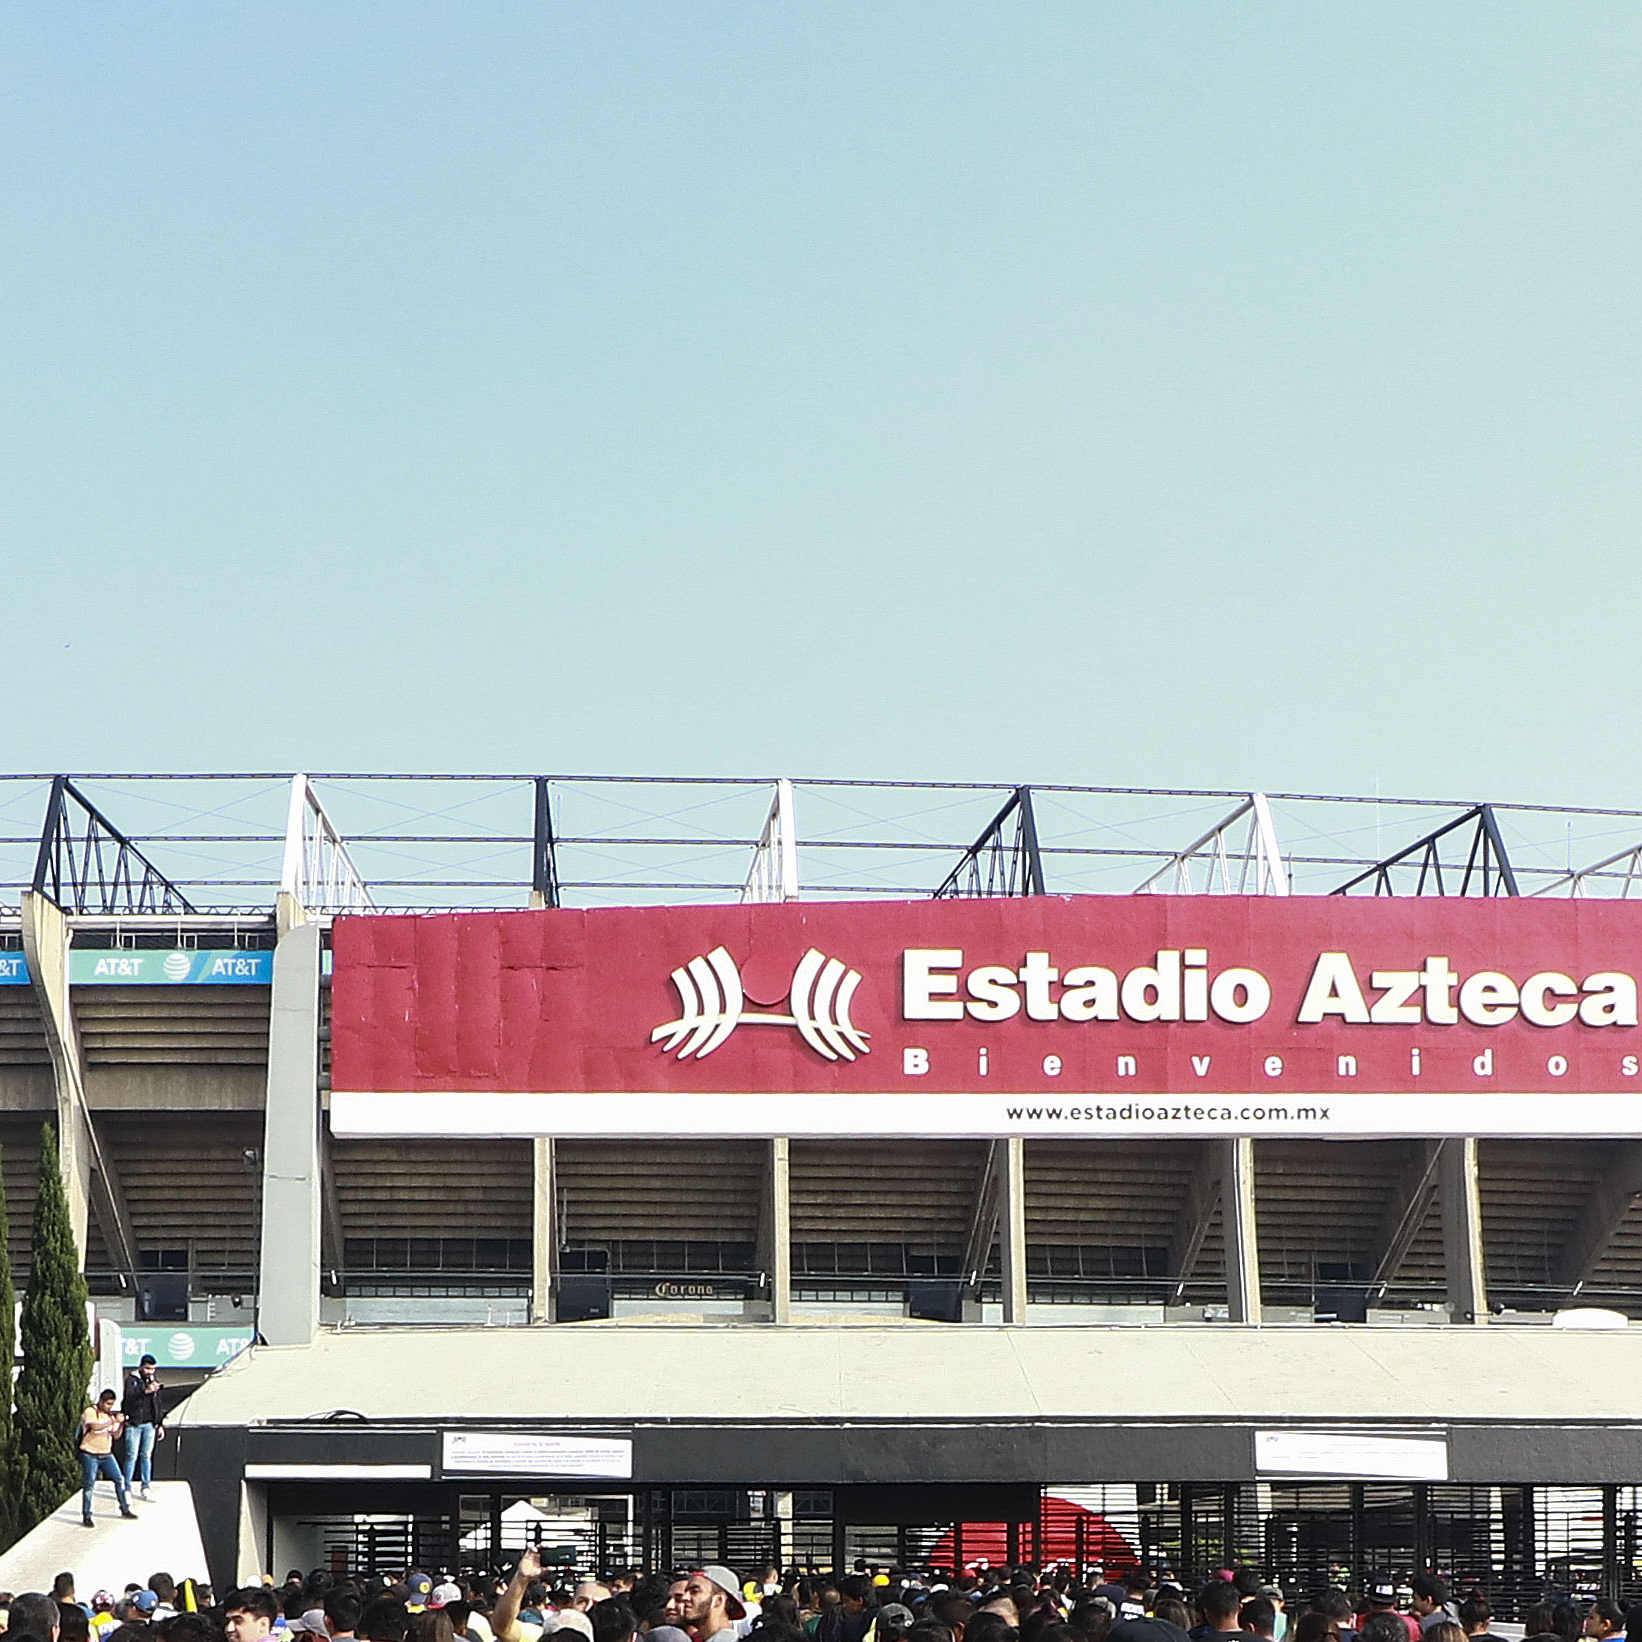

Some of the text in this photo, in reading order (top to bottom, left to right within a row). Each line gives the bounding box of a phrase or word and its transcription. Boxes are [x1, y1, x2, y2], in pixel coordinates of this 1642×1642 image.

[94, 957, 262, 977] AT&T AT&T
[902, 948, 1640, 1028] Estadio Azteca
[902, 1046, 1640, 1077] Bienvenidos
[1005, 1103, 1331, 1122] www.estadioazteca.com.mx
[655, 1281, 714, 1297] Corona
